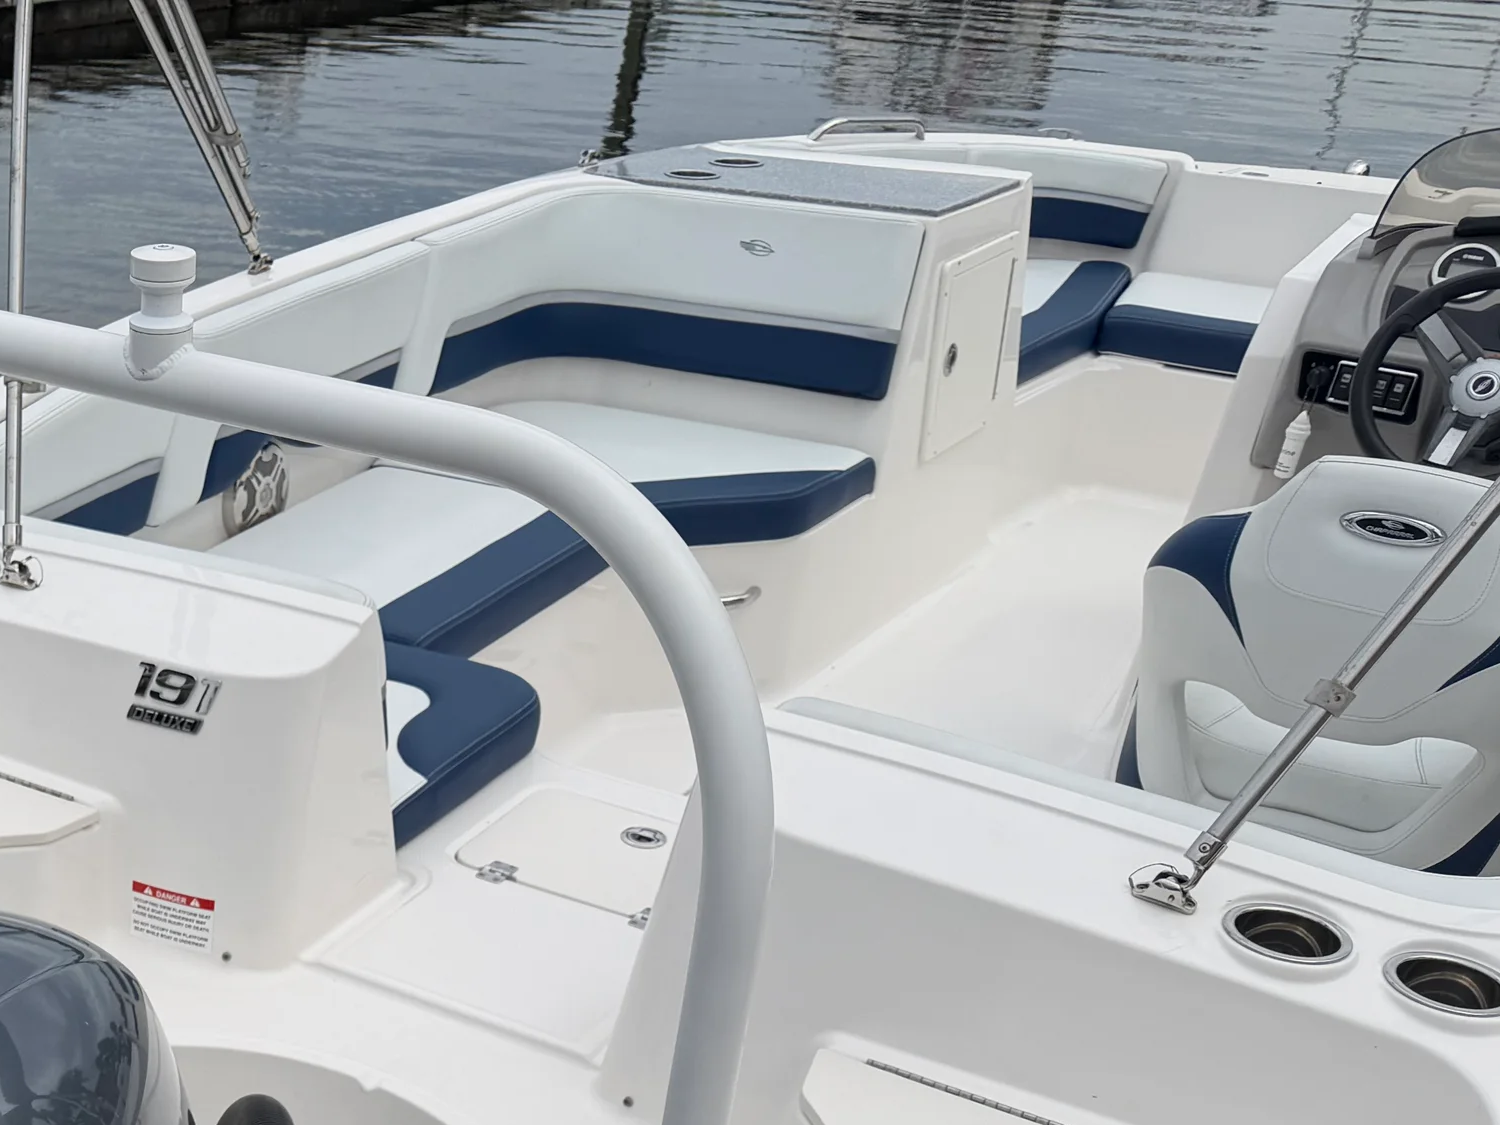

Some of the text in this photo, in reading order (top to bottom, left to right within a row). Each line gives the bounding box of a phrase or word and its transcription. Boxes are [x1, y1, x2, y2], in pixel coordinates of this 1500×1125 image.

[1366, 526, 1414, 539] CHAPARRAL
[134, 662, 222, 715] 191
[132, 707, 195, 732] DELUXE
[156, 890, 186, 904] DANGER
